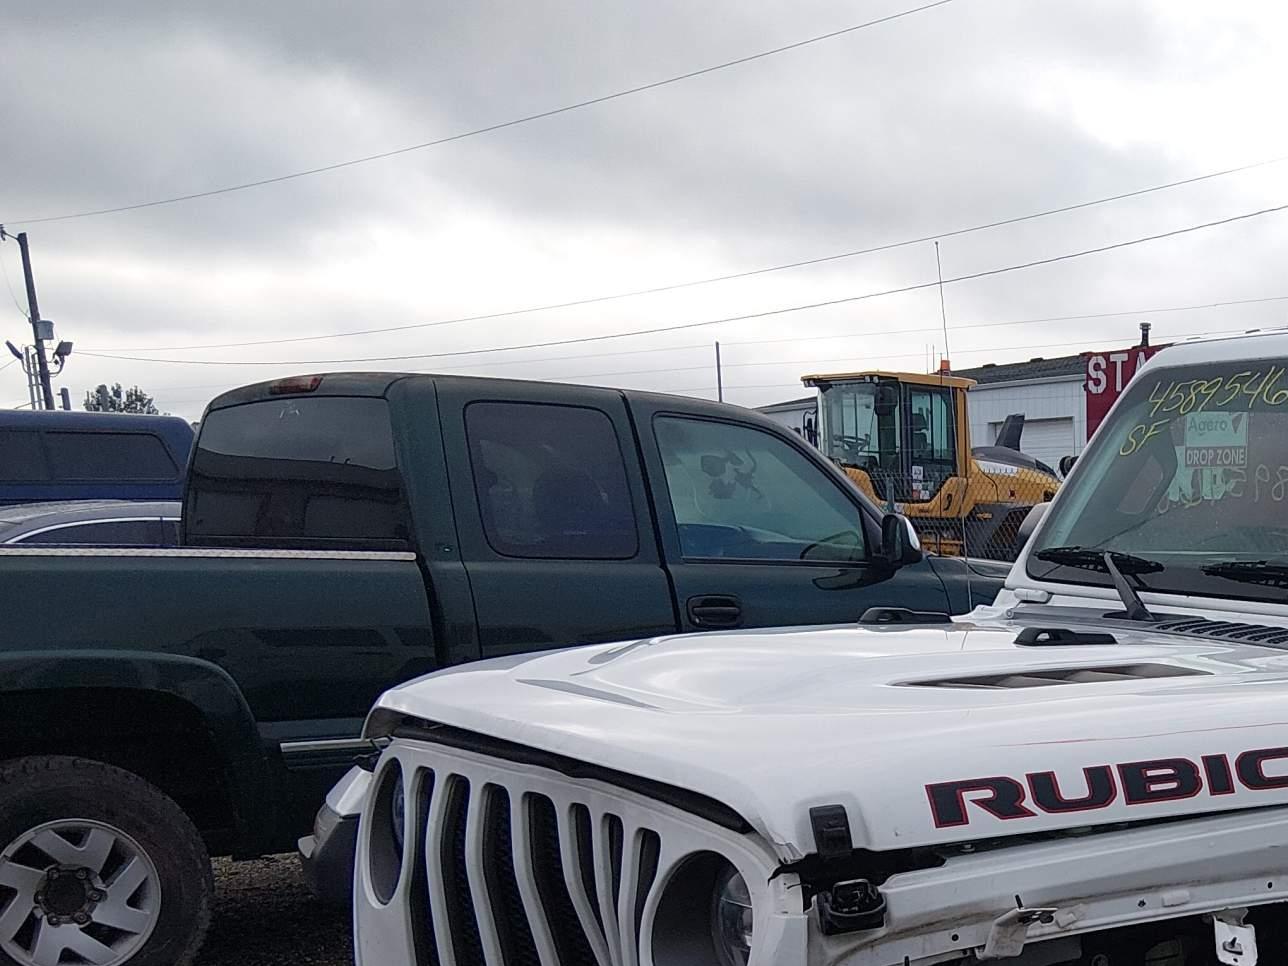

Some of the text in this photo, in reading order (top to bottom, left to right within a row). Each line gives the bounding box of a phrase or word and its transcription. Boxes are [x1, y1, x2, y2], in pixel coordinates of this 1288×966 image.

[1188, 417, 1228, 436] Agero
[1120, 418, 1170, 456] SF
[1186, 448, 1245, 465] DROP ZONE
